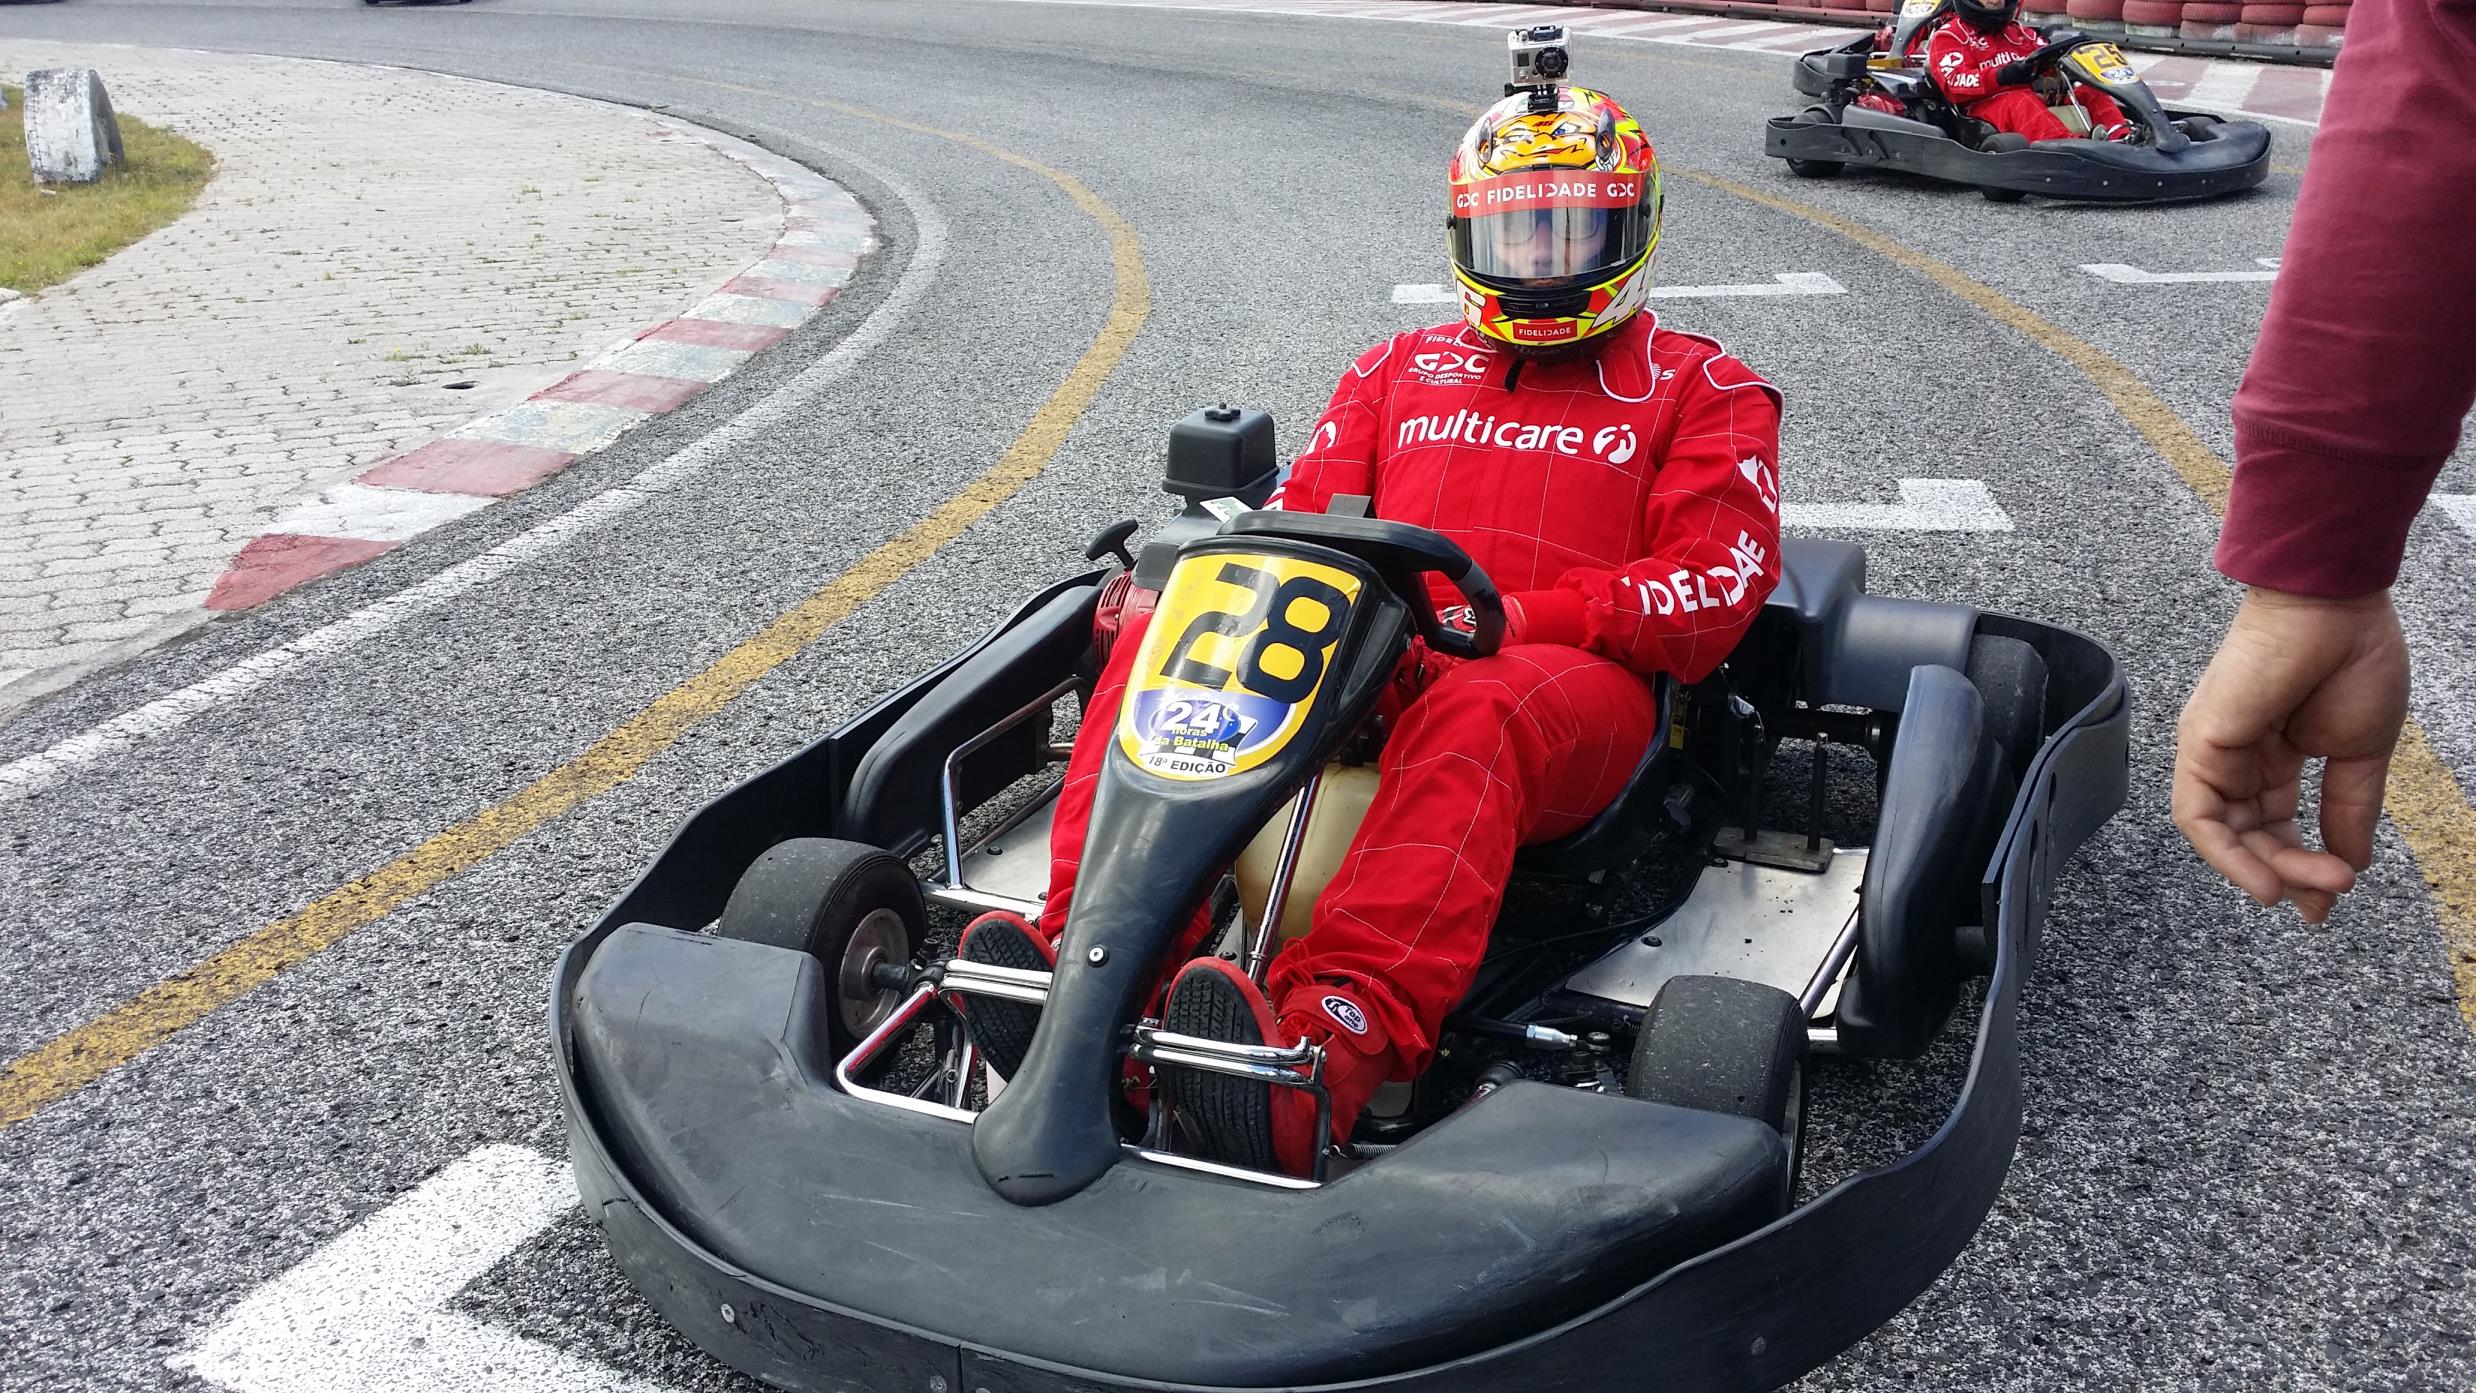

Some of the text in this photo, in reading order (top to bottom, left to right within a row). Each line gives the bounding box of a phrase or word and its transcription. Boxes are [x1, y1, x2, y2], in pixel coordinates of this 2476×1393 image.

[1487, 182, 1597, 205] FIDELIDADE
[1518, 326, 1572, 337] FIDELIDADE
[1408, 367, 1482, 380] GRUPO DESPORTIVO
[1398, 408, 1584, 455] multicare
[1160, 561, 1352, 704] 28
[1160, 699, 1223, 733] 24
[1173, 735, 1230, 752] Batalha
[1170, 759, 1226, 774] EDIÇÃO
